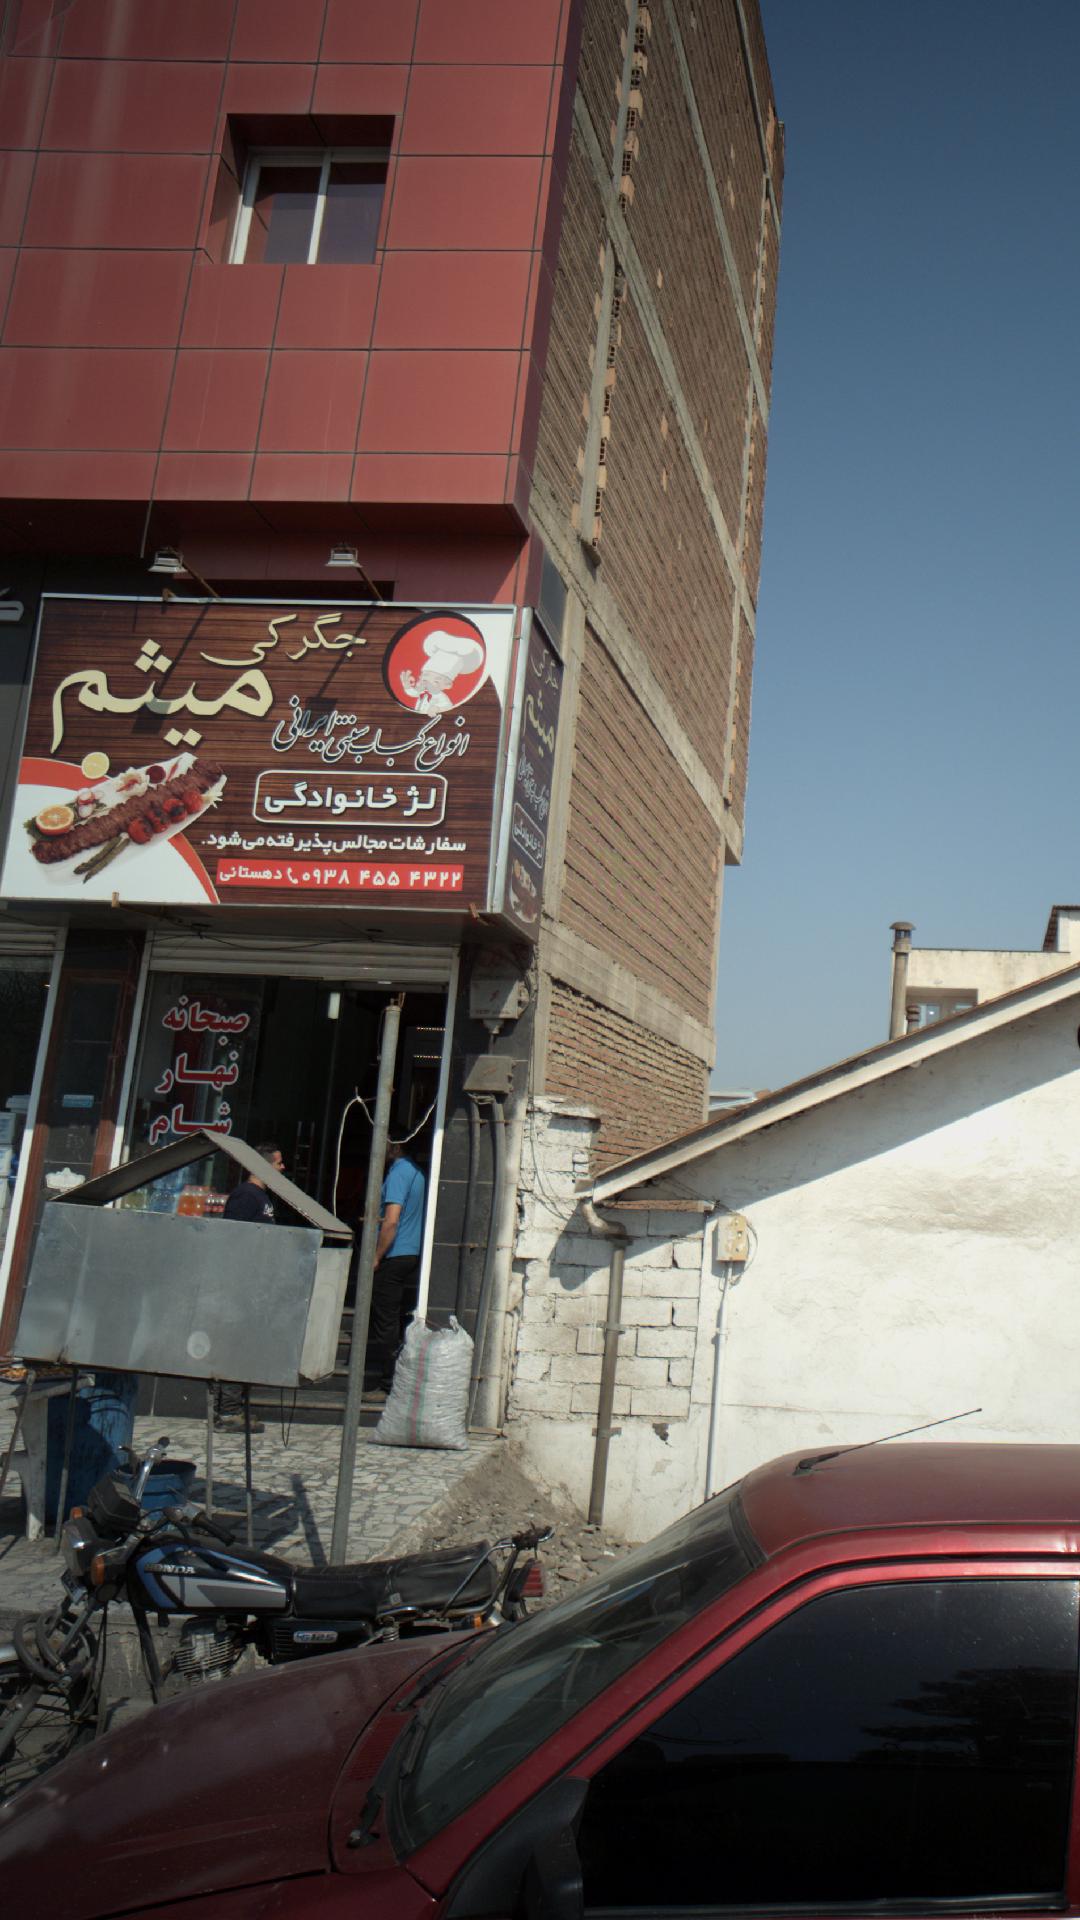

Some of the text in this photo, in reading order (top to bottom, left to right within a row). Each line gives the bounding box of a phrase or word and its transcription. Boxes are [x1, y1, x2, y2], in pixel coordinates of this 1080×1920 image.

[51, 639, 274, 755] میثم
[272, 694, 338, 752] ایرانی
[347, 714, 442, 767] کباب
[414, 715, 471, 772] انواع
[263, 782, 437, 816] لژ خانوادگی
[265, 832, 333, 856] پذیرفته
[331, 834, 388, 854] مجالس
[387, 835, 466, 855] سفارشات
[219, 865, 461, 888] ۰۹۳۸ ۴۵۵ ۴۳۲۲ دهستانی
[162, 995, 250, 1046] صبحانه
[154, 1050, 239, 1094] نهار
[150, 1102, 232, 1146] شام
